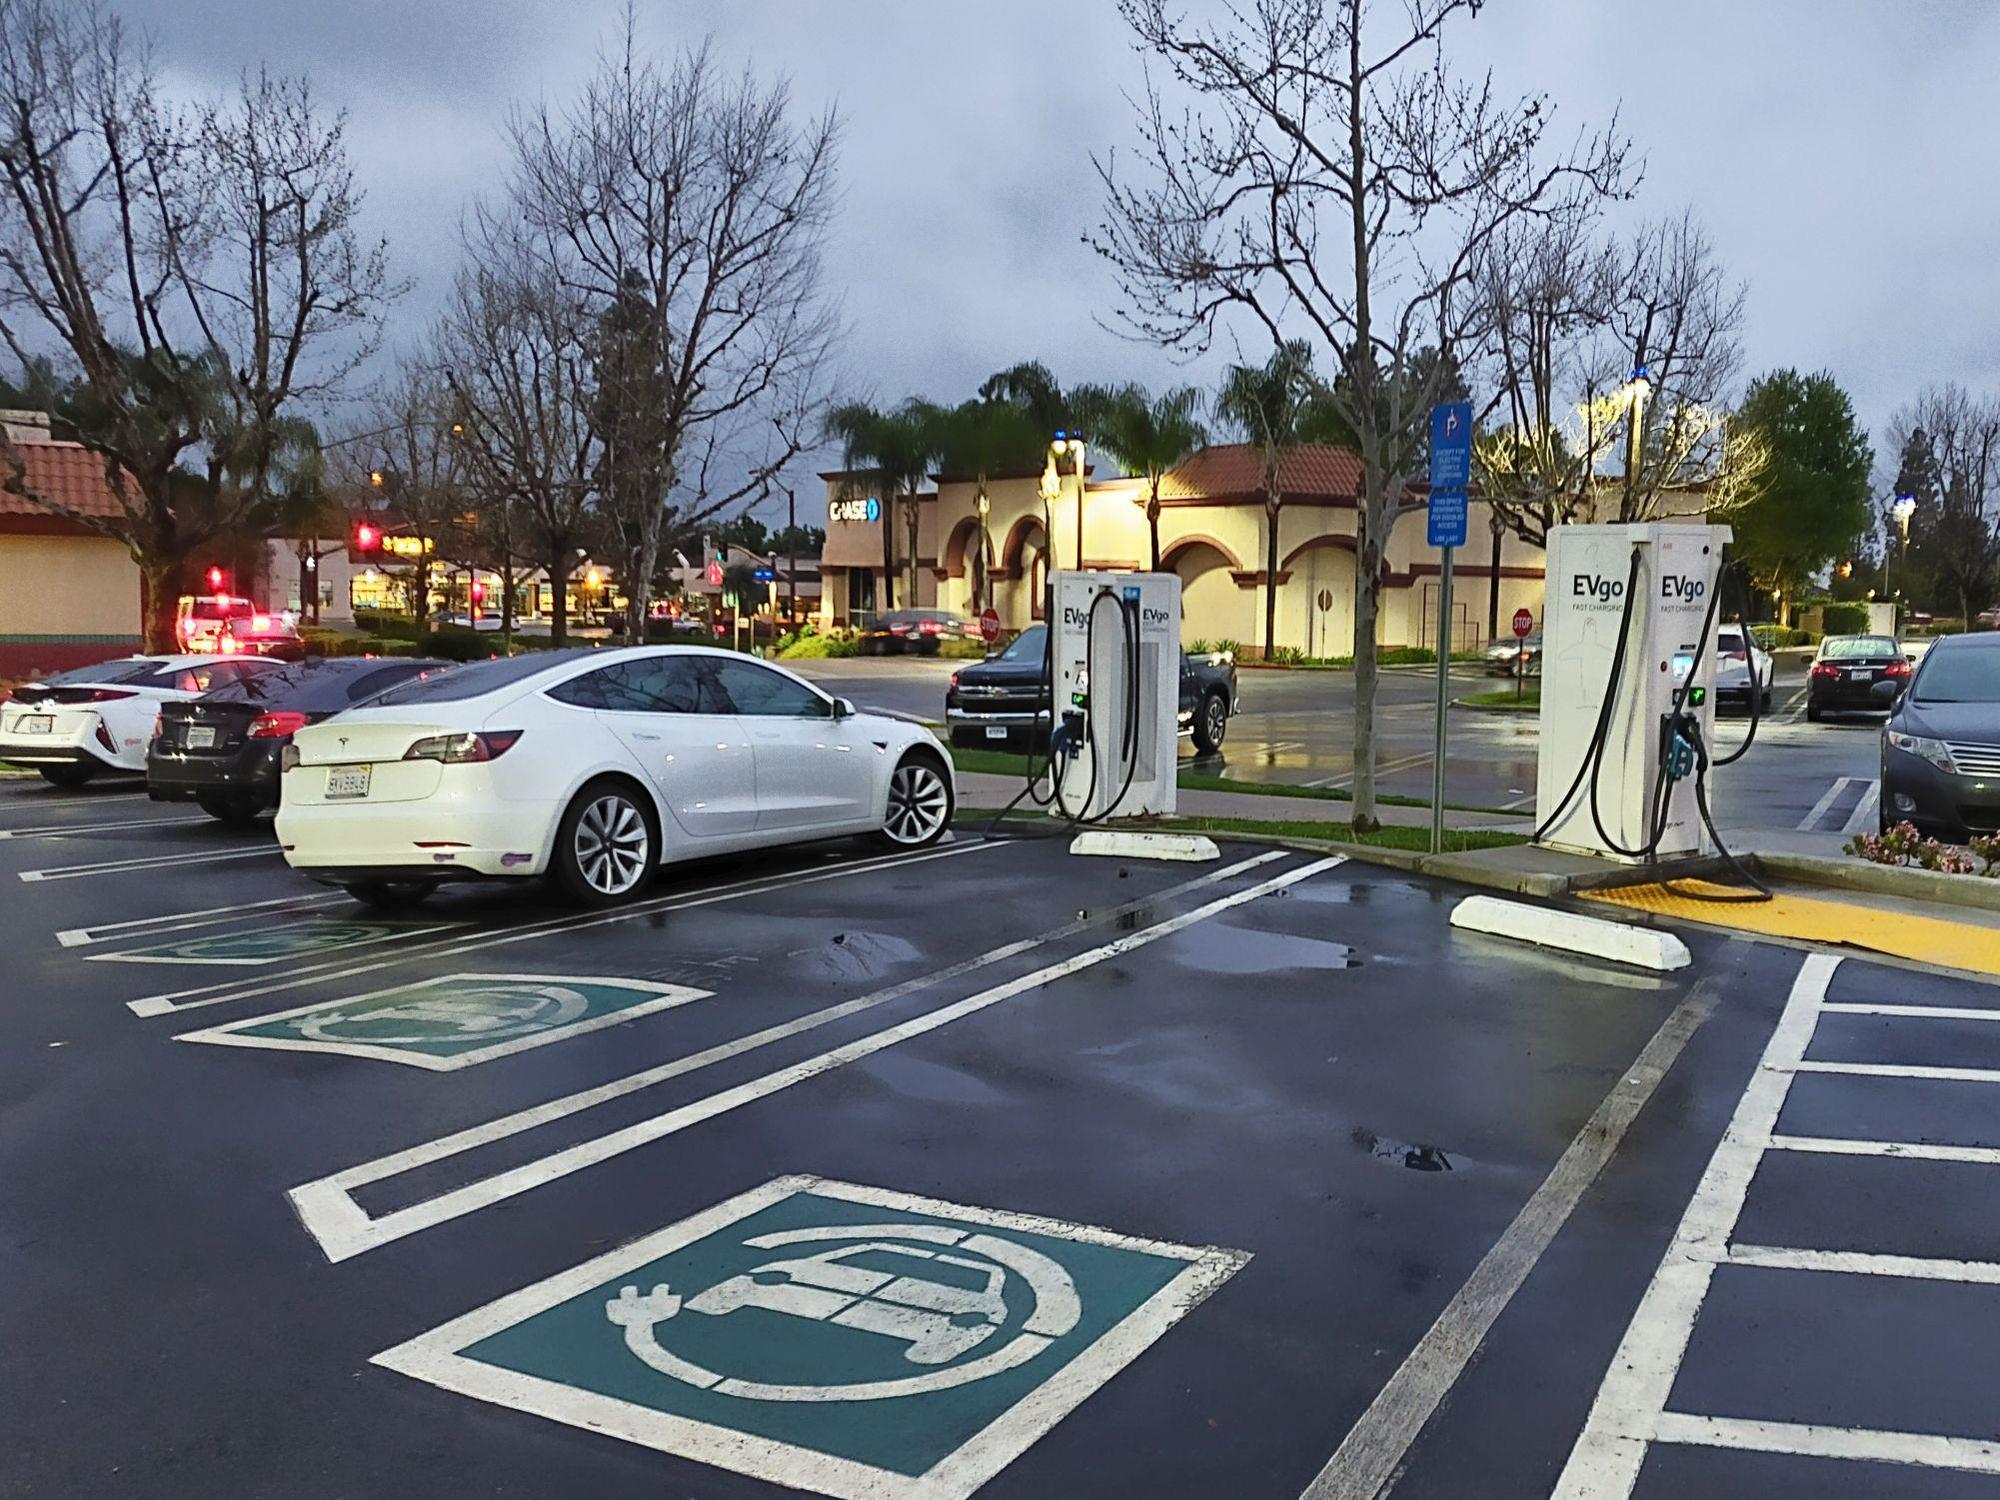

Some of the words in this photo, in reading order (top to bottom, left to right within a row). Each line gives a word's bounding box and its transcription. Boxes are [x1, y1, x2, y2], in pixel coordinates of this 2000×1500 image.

[1573, 574, 1624, 602] EVgo
[1661, 575, 1705, 603] EVgo
[1143, 609, 1169, 624] EVgo
[1514, 616, 1531, 630] STOP
